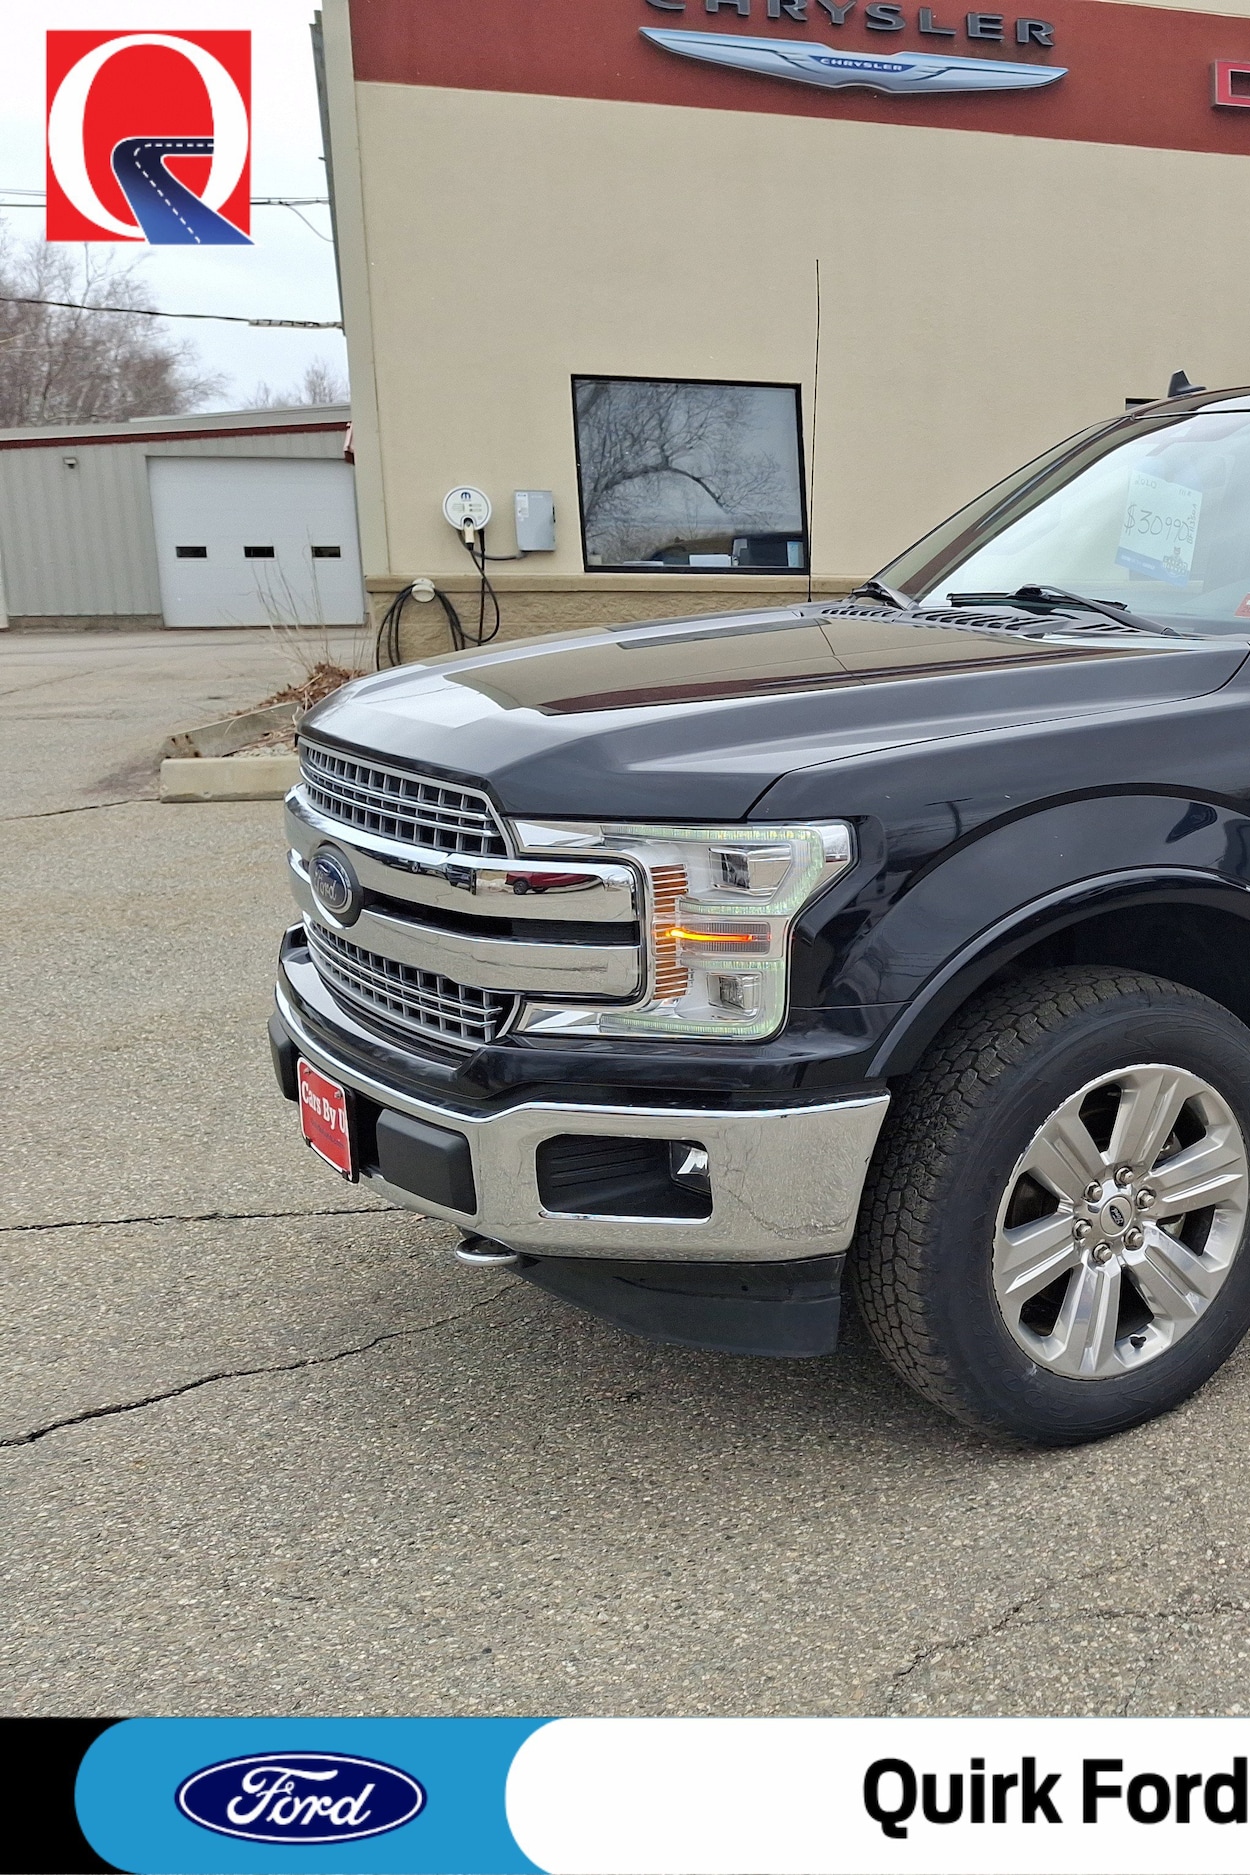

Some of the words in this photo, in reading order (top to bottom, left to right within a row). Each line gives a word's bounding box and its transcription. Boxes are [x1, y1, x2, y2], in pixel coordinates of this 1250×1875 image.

[820, 57, 903, 71] CHRYSLER
[301, 1081, 321, 1115] Cars
[323, 1097, 336, 1130] By
